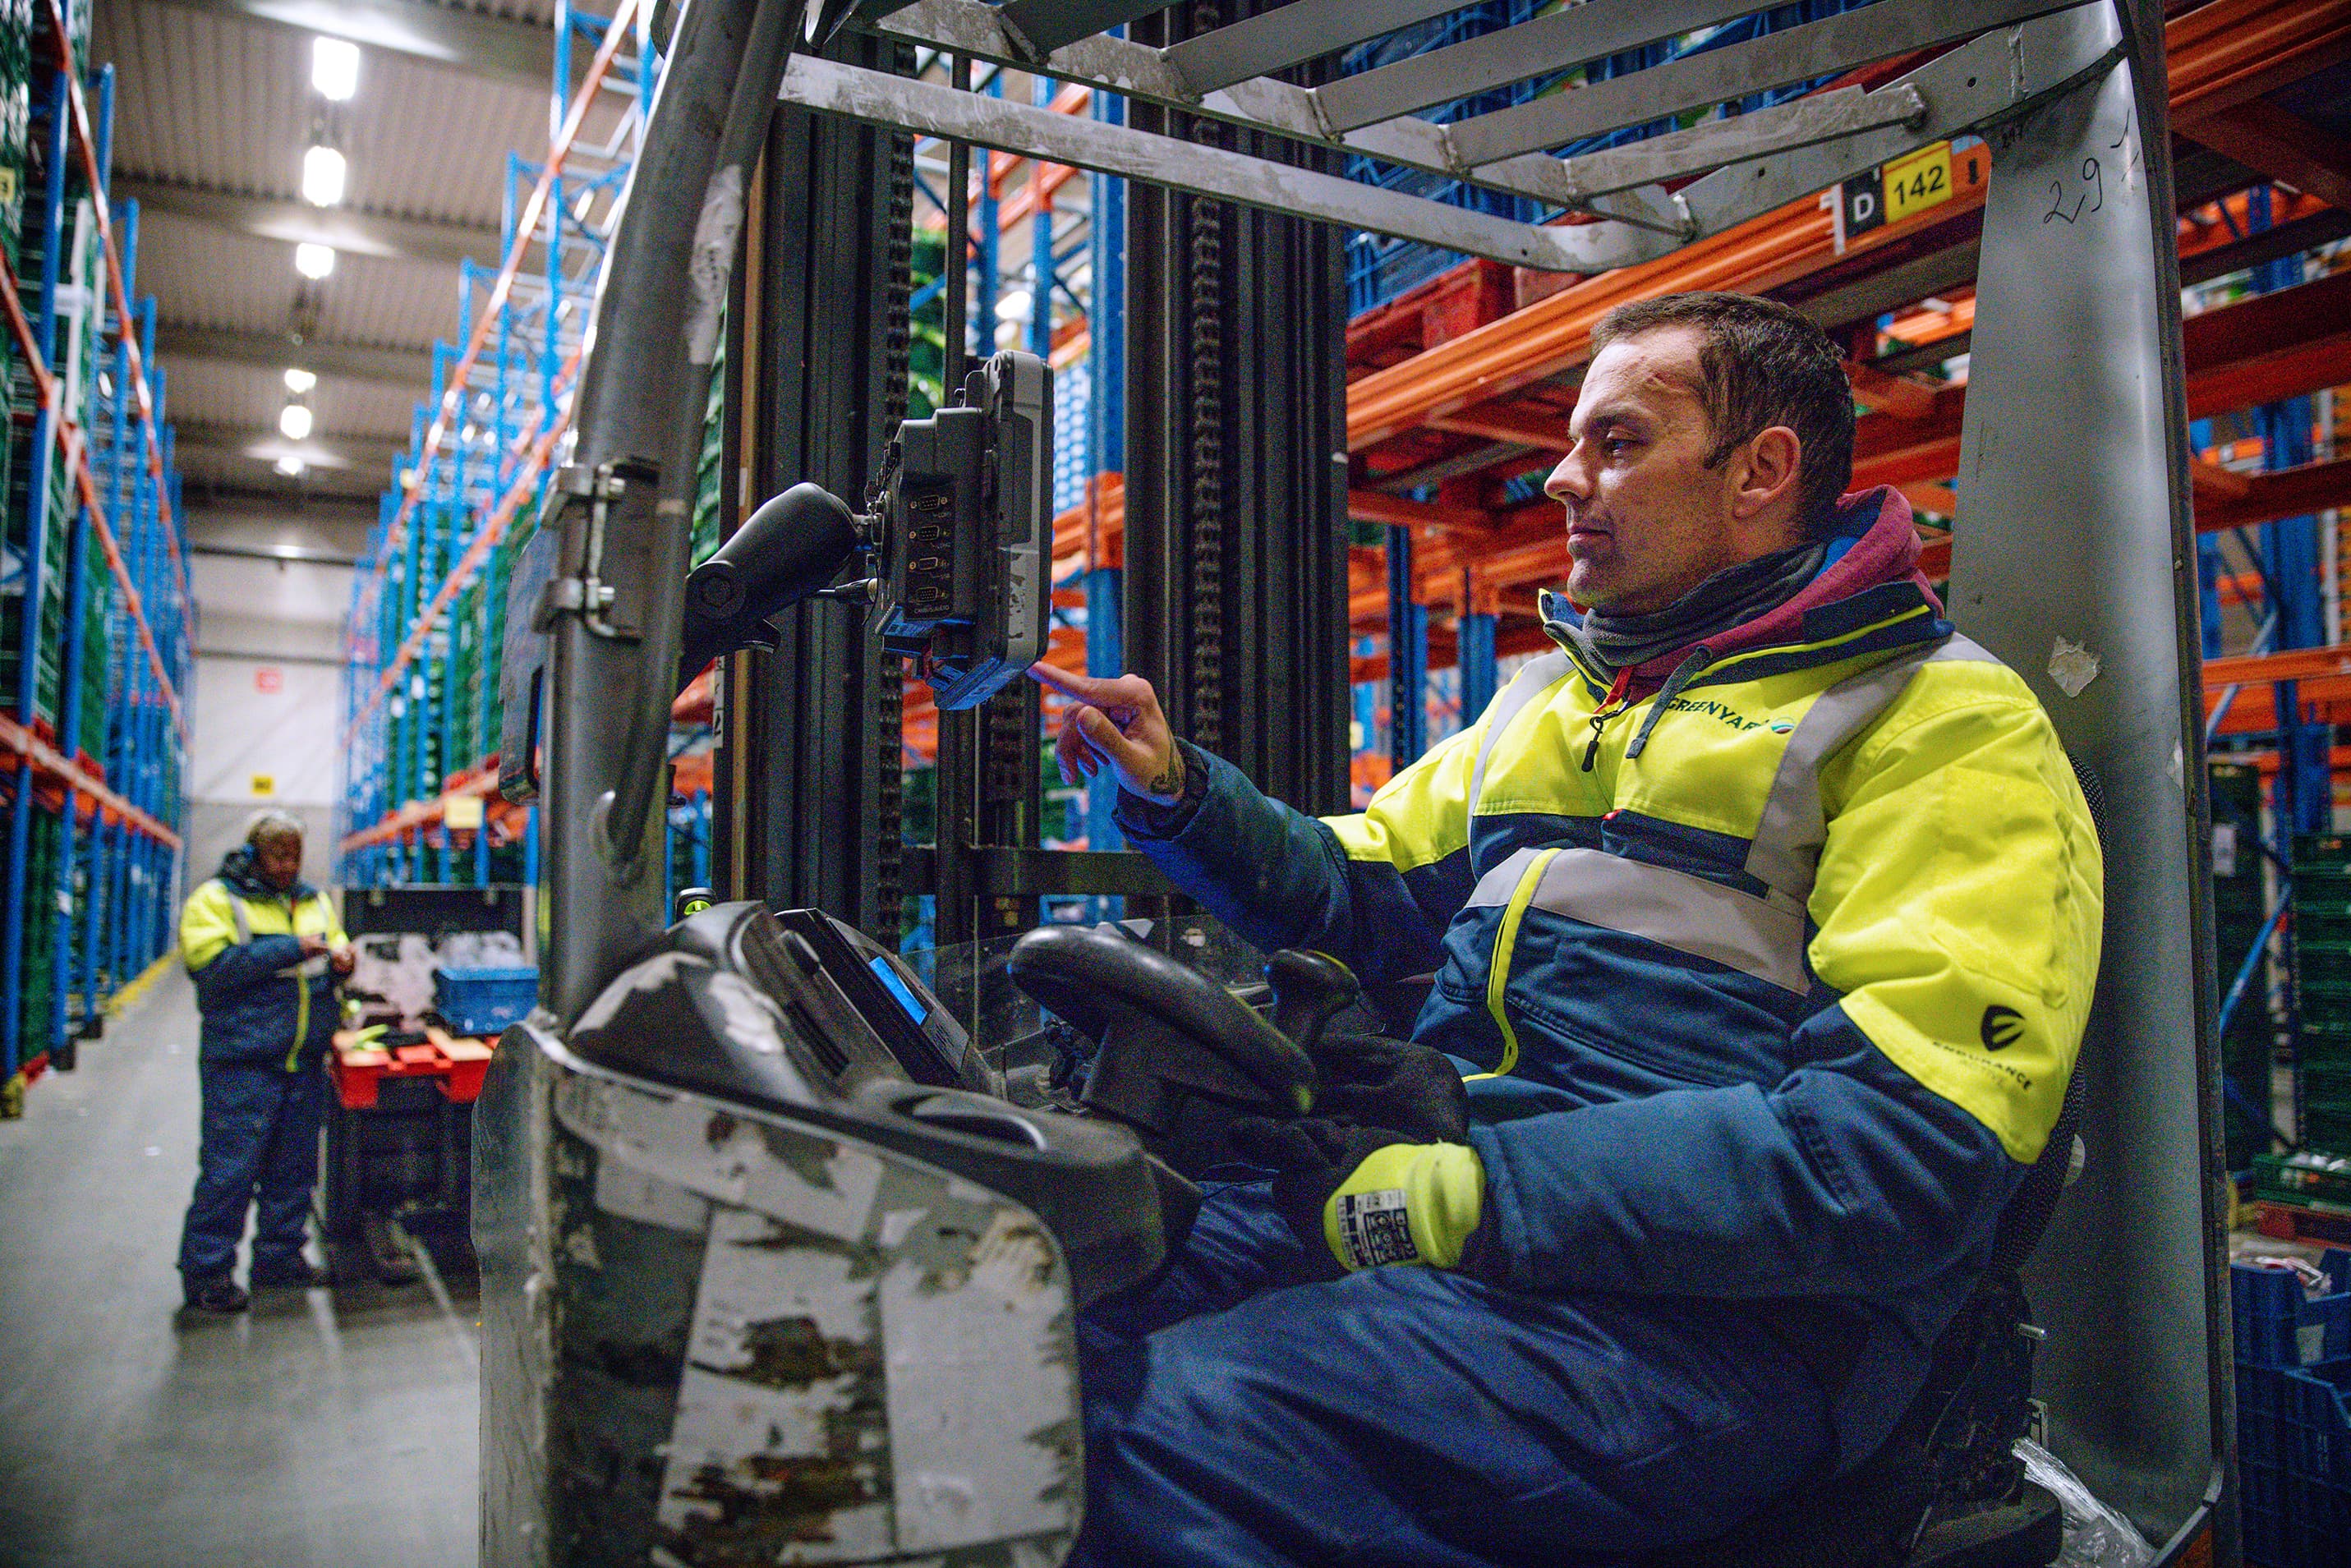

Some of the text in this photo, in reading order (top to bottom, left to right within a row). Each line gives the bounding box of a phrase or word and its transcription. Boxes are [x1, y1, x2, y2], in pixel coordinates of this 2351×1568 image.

[1853, 165, 1945, 223] D 142
[1668, 697, 1769, 731] GREENYAR
